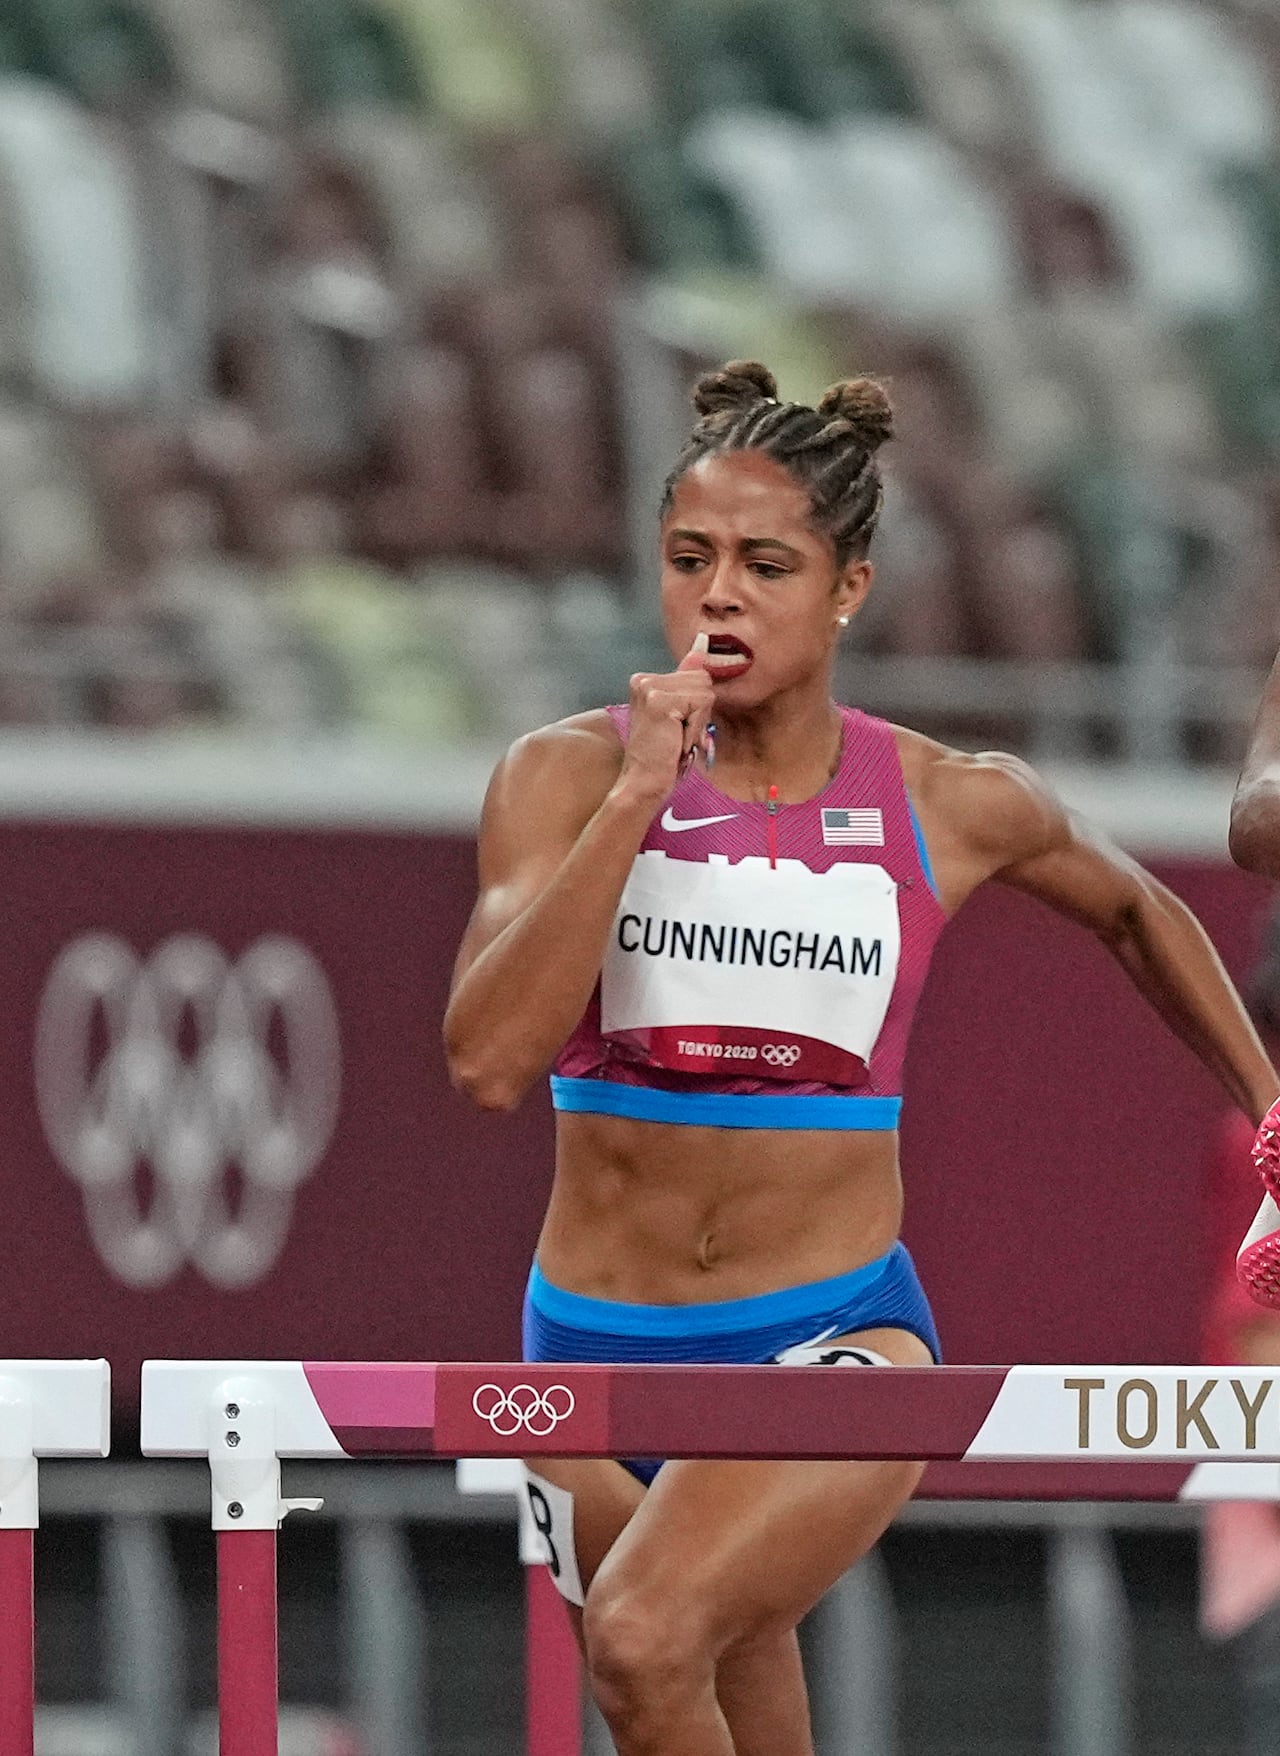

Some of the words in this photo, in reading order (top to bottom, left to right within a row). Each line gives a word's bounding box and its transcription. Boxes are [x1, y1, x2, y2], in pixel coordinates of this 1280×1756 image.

[618, 914, 882, 977] CUNNINGHAM
[677, 1040, 722, 1058] TOKYO
[723, 1045, 758, 1060] 2020
